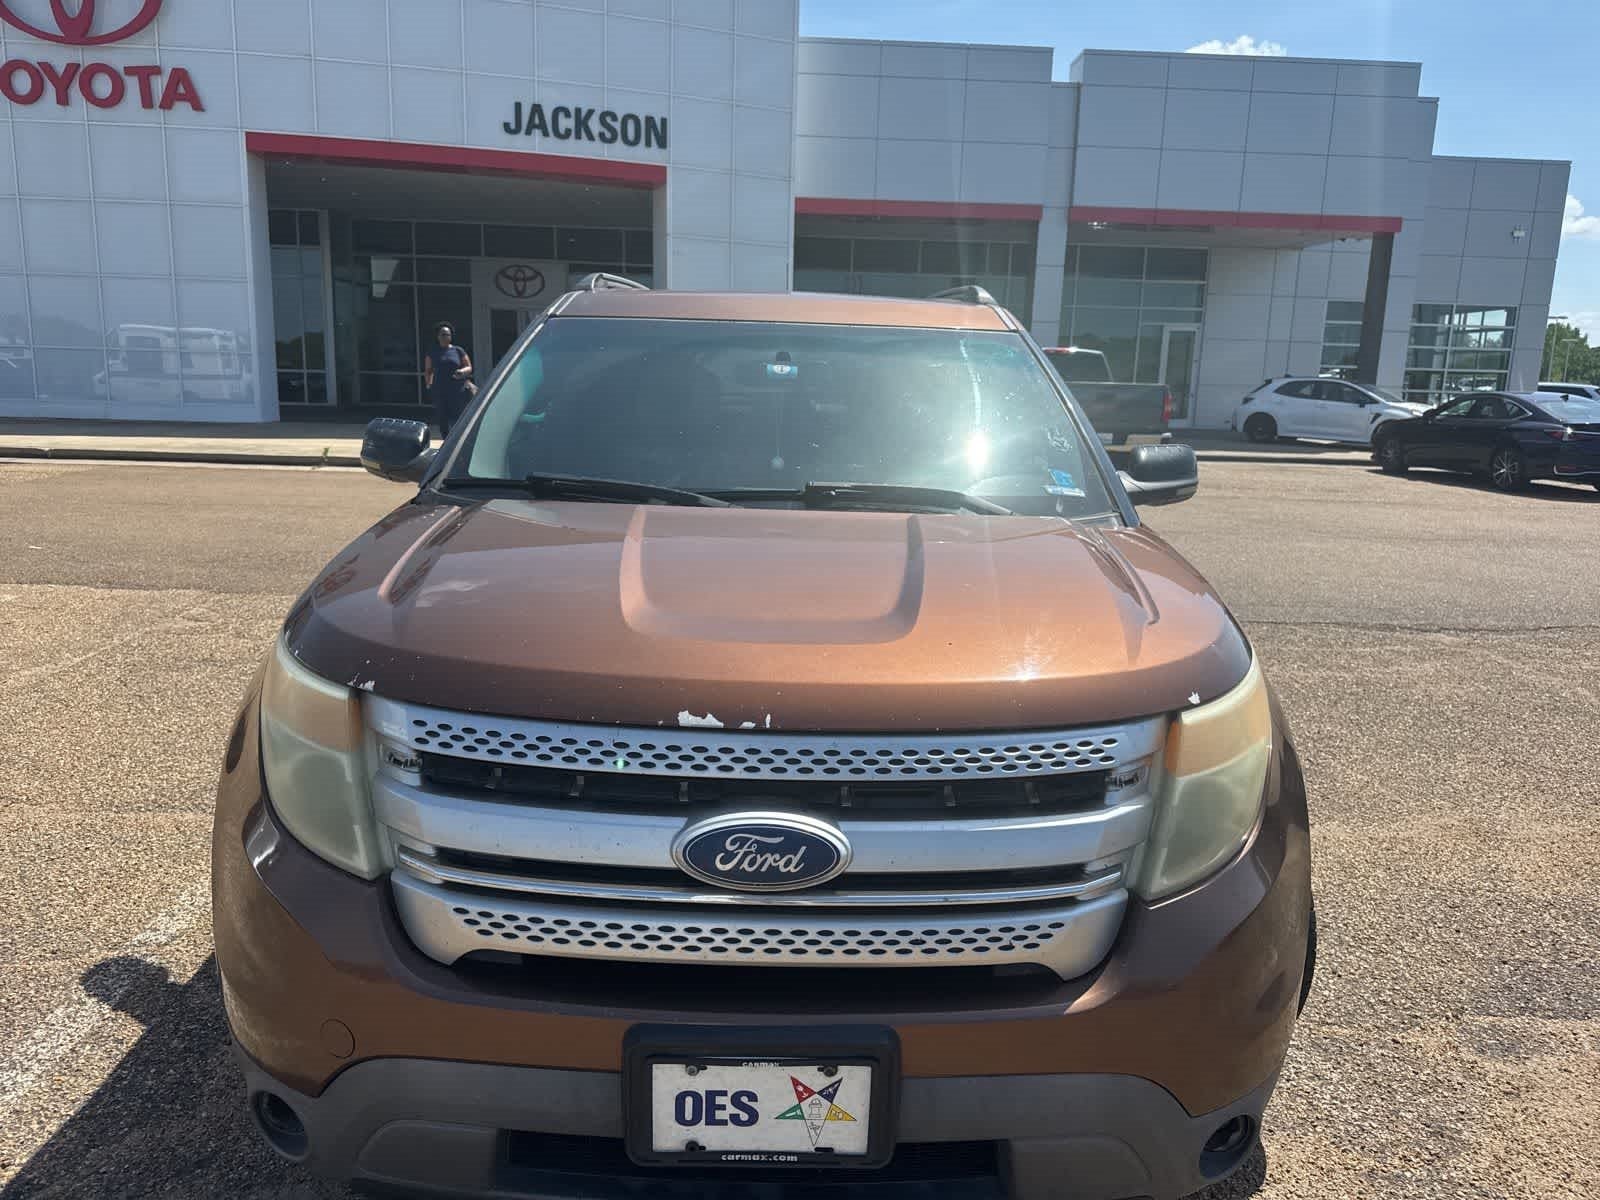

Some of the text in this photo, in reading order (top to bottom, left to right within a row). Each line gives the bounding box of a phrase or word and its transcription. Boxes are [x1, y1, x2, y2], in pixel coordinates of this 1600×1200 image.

[503, 101, 667, 149] JACKSON
[714, 833, 807, 873] Ford
[674, 1090, 760, 1127] OES
[720, 1154, 798, 1162] carmax.com
